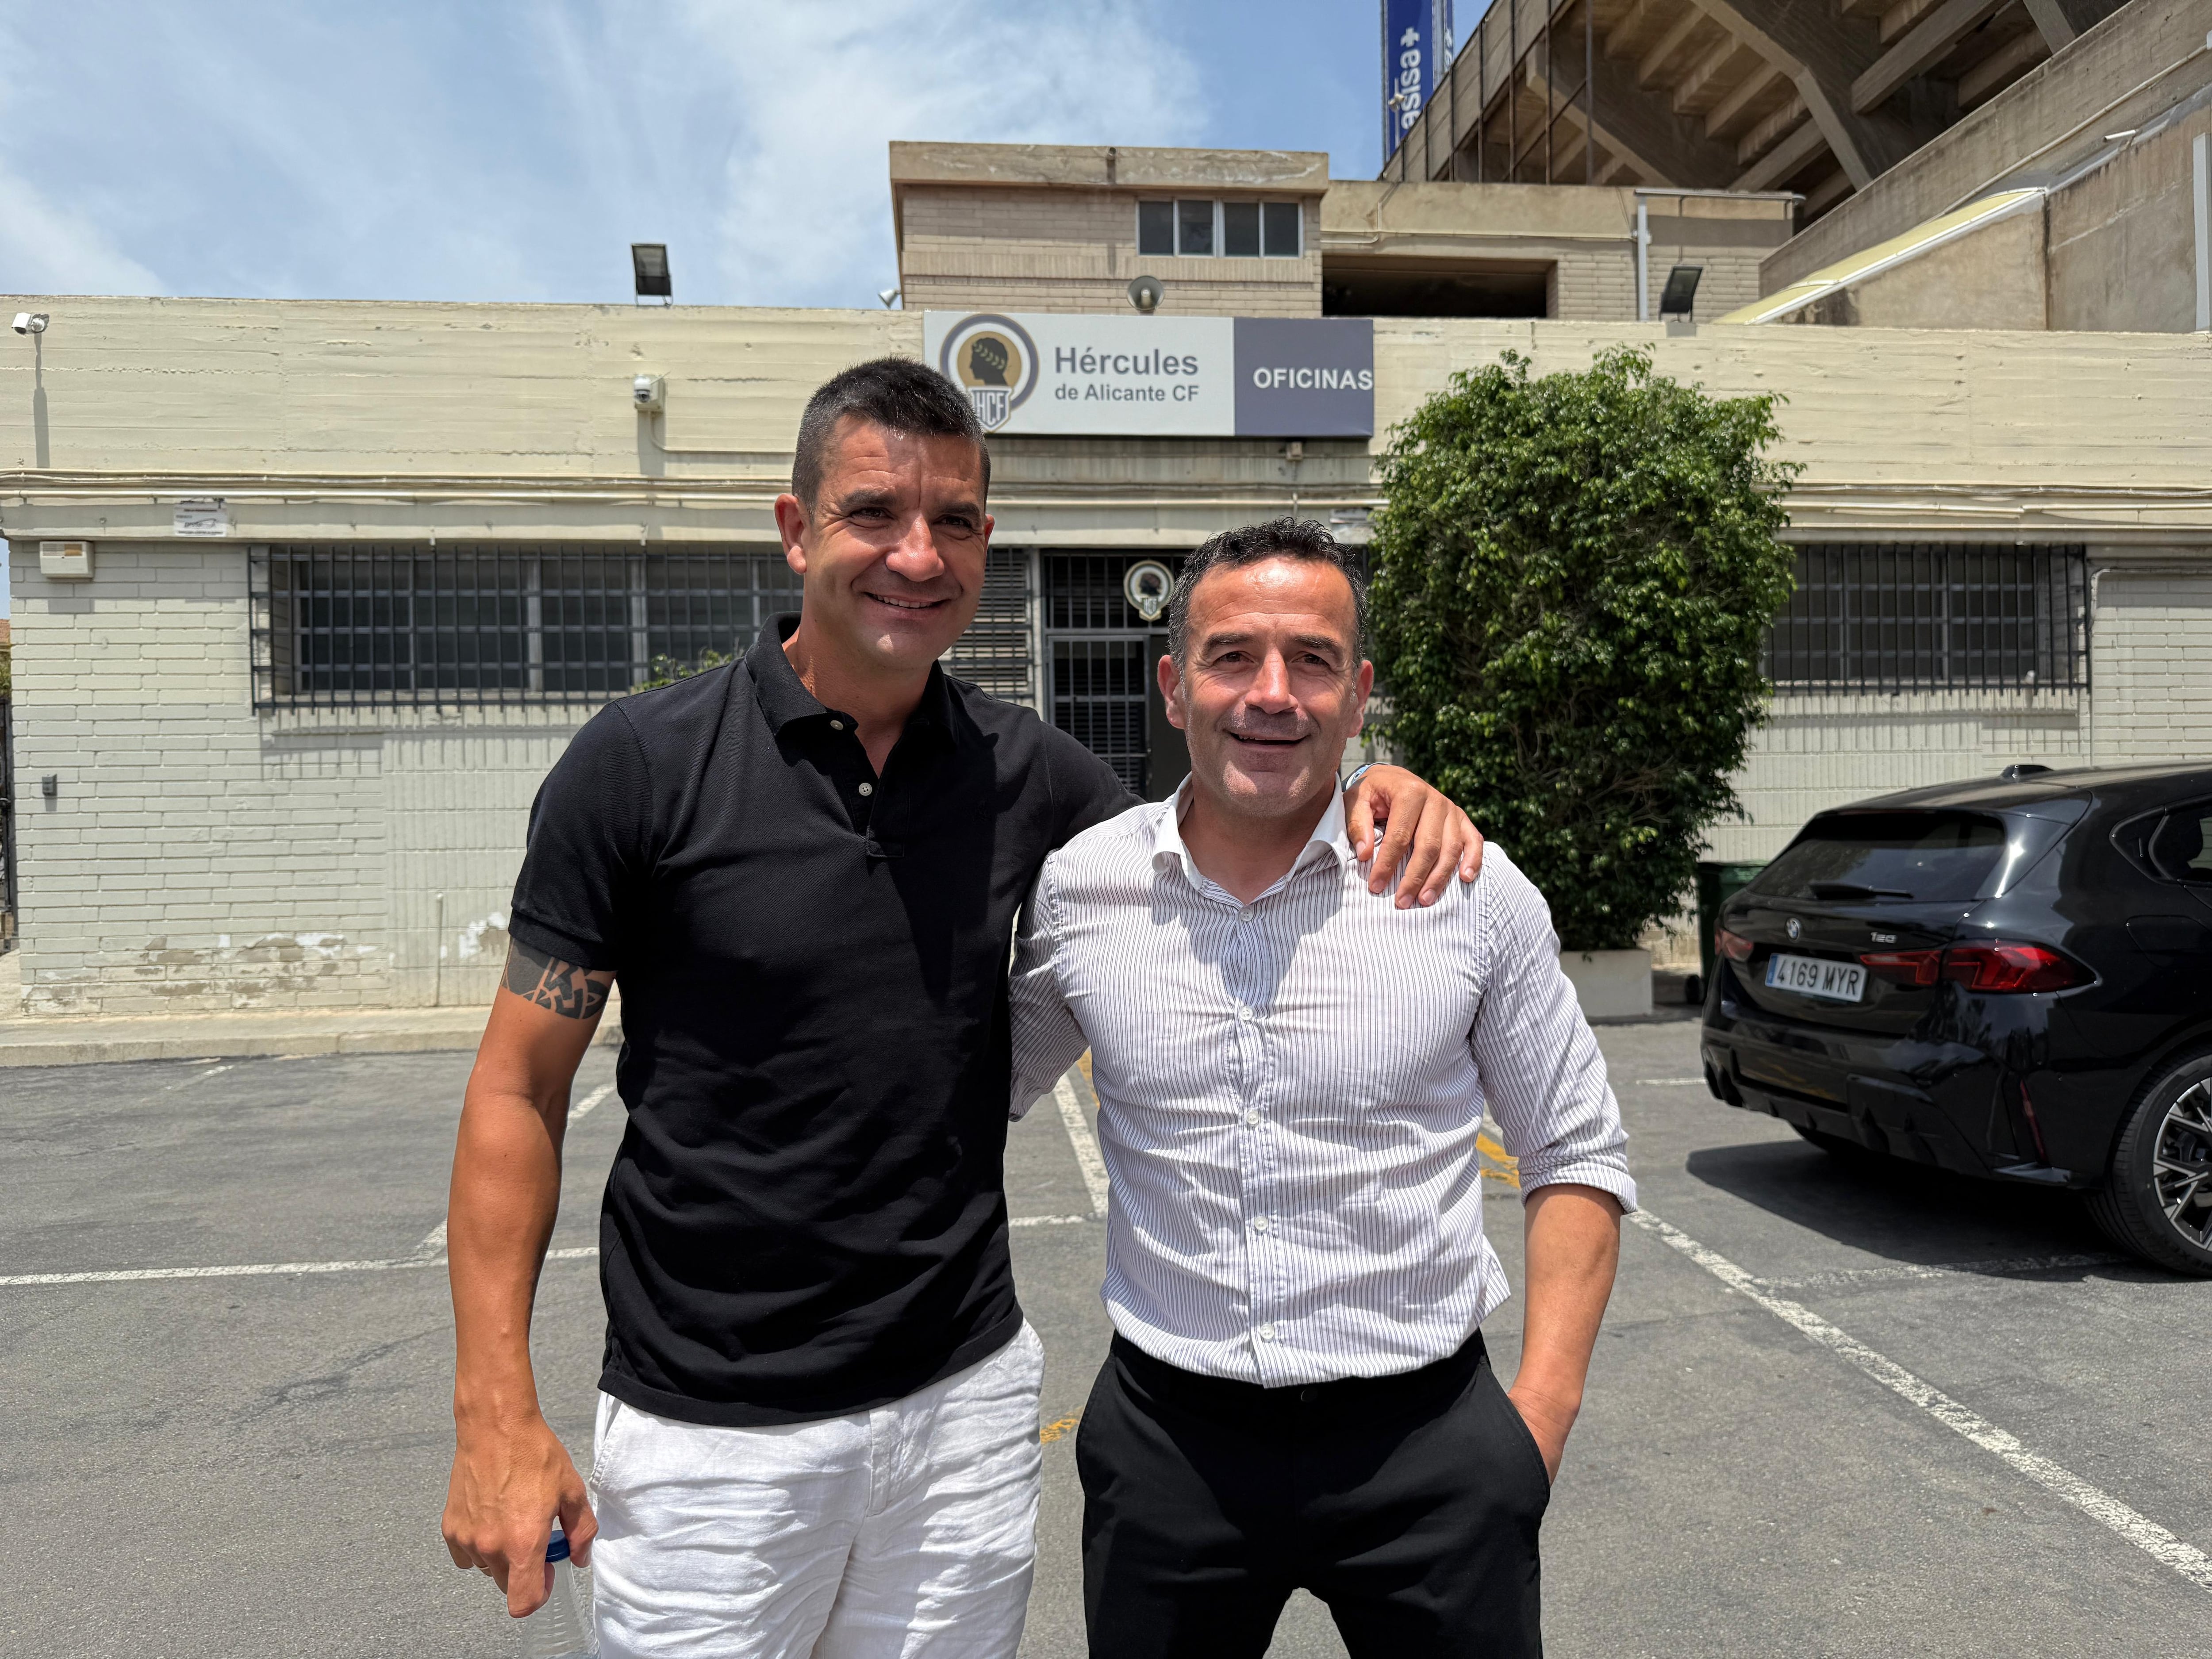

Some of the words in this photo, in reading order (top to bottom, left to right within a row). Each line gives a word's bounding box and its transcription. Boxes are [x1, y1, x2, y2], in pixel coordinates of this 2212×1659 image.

[1055, 347, 1198, 376] Hércules
[1055, 383, 1078, 400] de
[1084, 384, 1165, 401] Alicante
[1173, 385, 1199, 401] CF
[1253, 367, 1373, 390] OFICINAS
[976, 392, 1005, 426] HCF
[1777, 959, 1818, 987] 4169
[1822, 965, 1859, 995] MYR
